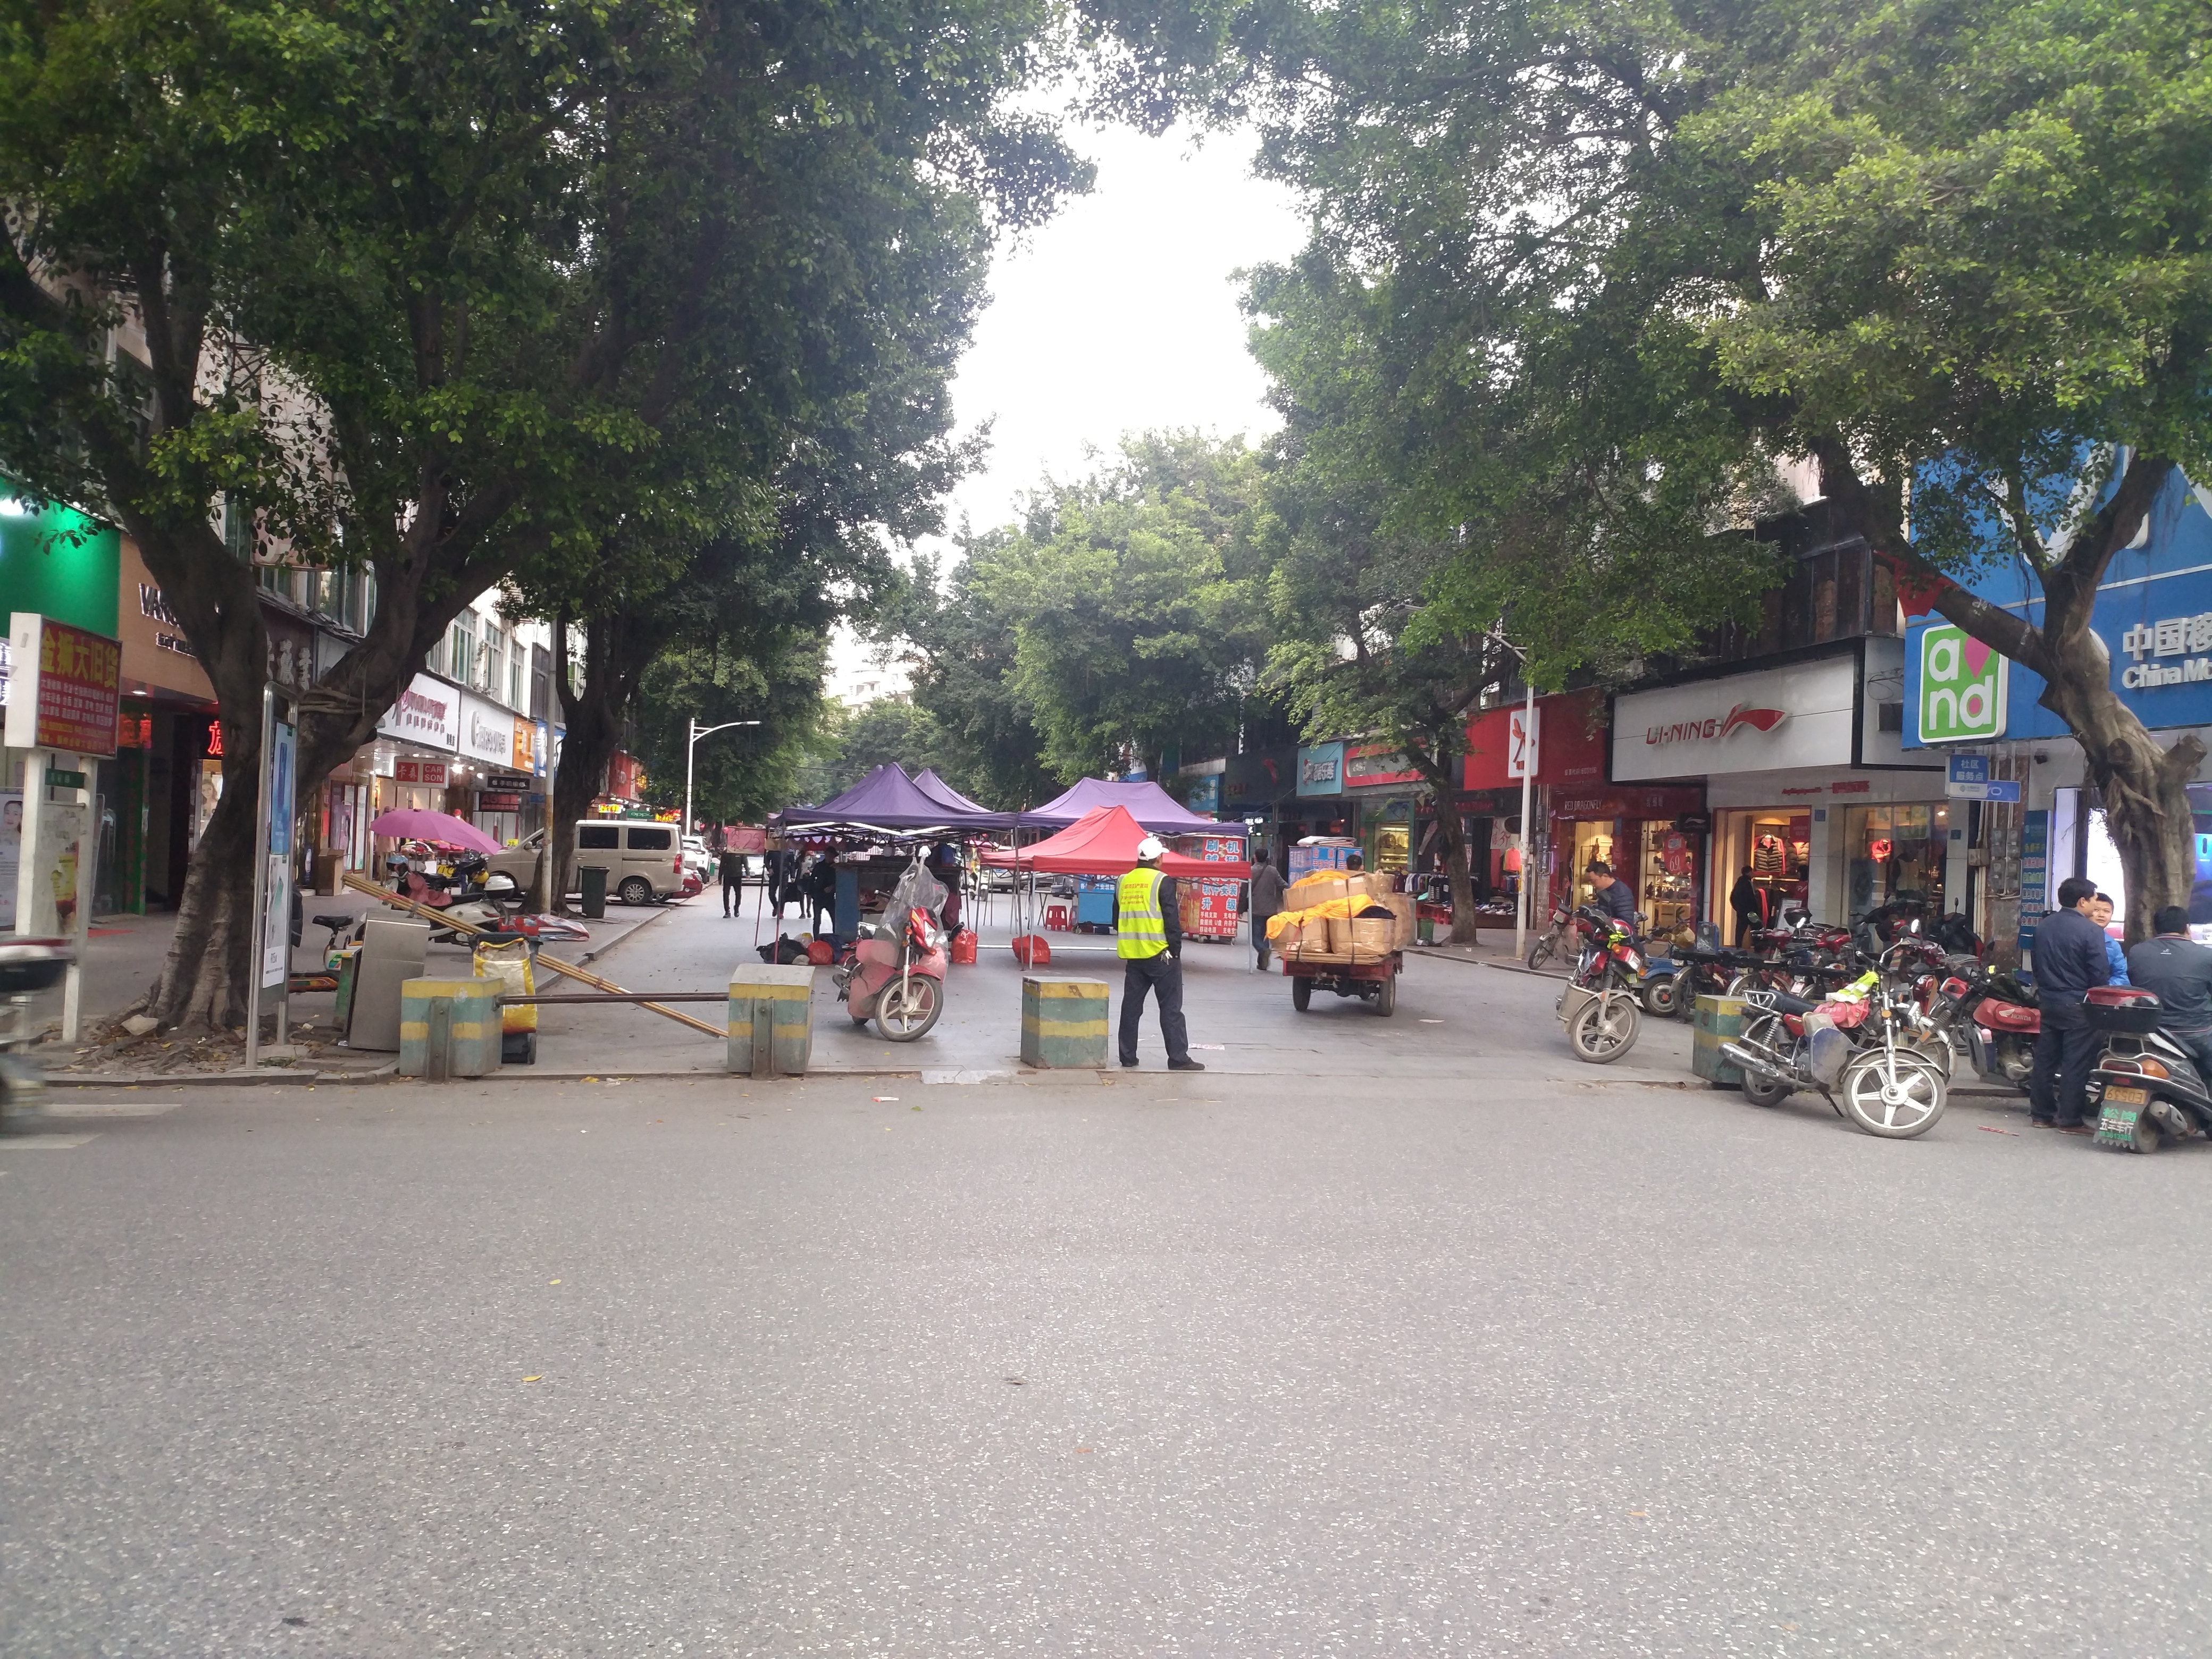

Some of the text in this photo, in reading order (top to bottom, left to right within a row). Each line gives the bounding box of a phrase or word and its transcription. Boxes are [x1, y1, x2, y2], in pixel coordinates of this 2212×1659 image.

[2123, 612, 2212, 660] 中国移
[2122, 664, 2183, 689] China
[1960, 759, 1979, 769] 社区
[1956, 771, 1983, 781] 服务点
[1574, 800, 1603, 811] DRAGONFLY
[743, 833, 761, 850] 25
